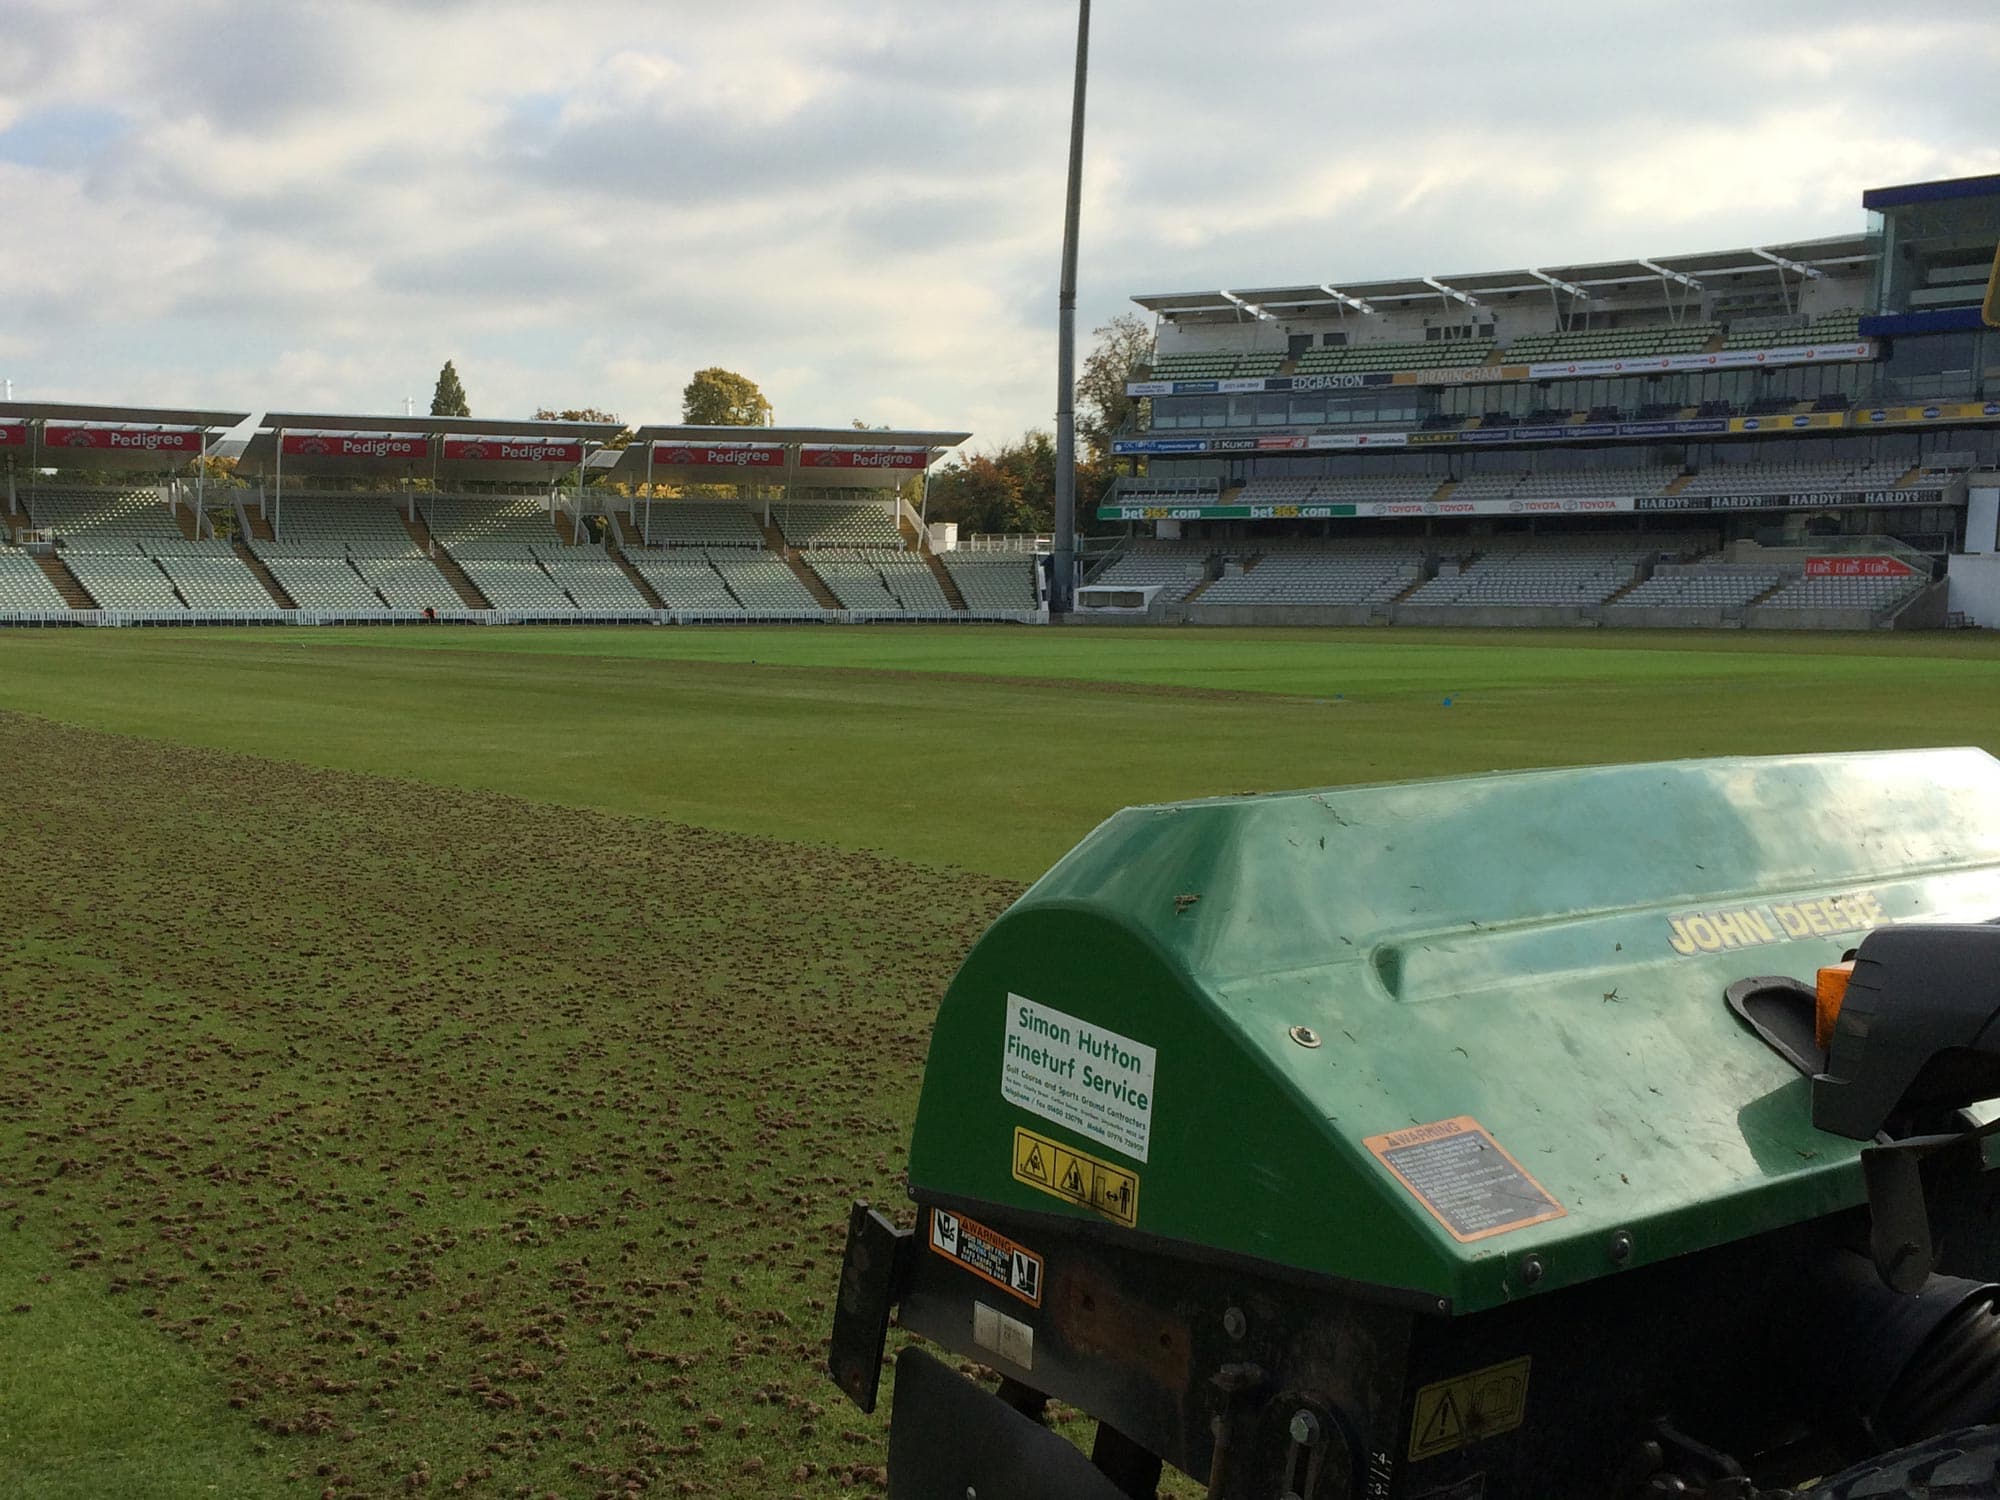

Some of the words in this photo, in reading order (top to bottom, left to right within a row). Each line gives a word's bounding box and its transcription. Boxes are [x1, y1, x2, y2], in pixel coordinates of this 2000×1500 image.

[1291, 375, 1364, 389] EDGBASTON
[1416, 367, 1502, 384] BIRMINGHAM
[111, 433, 184, 449] Pedigree
[343, 441, 411, 457] Pedigree
[501, 446, 566, 461] Pedigree
[708, 450, 770, 466] Pedigree
[853, 453, 913, 468] Pedigree
[1121, 506, 1201, 519] bet365.com
[1250, 505, 1331, 518] bet365.com
[1387, 505, 1423, 514] TOYOTA
[1439, 503, 1475, 513] TOYOTA
[1525, 502, 1560, 511] TOYOTA
[1579, 501, 1616, 510] TOYOTA
[1667, 907, 1778, 956] JOHN
[1771, 892, 1890, 941] DEERE
[1019, 1006, 1070, 1045] Simon
[1078, 1030, 1141, 1075] Hutton
[1007, 1034, 1076, 1079] Fineturf
[1082, 1065, 1149, 1111] Service
[1006, 1063, 1019, 1076] Golf
[1021, 1069, 1042, 1086] Course
[1044, 1079, 1057, 1092] and
[1058, 1086, 1079, 1102] Sports
[1081, 1095, 1105, 1113] Ground
[1107, 1106, 1146, 1131] Contractors
[1399, 1121, 1462, 1145] WARNING
[968, 1222, 1011, 1254] WARNING
[1378, 1453, 1386, 1464] 4
